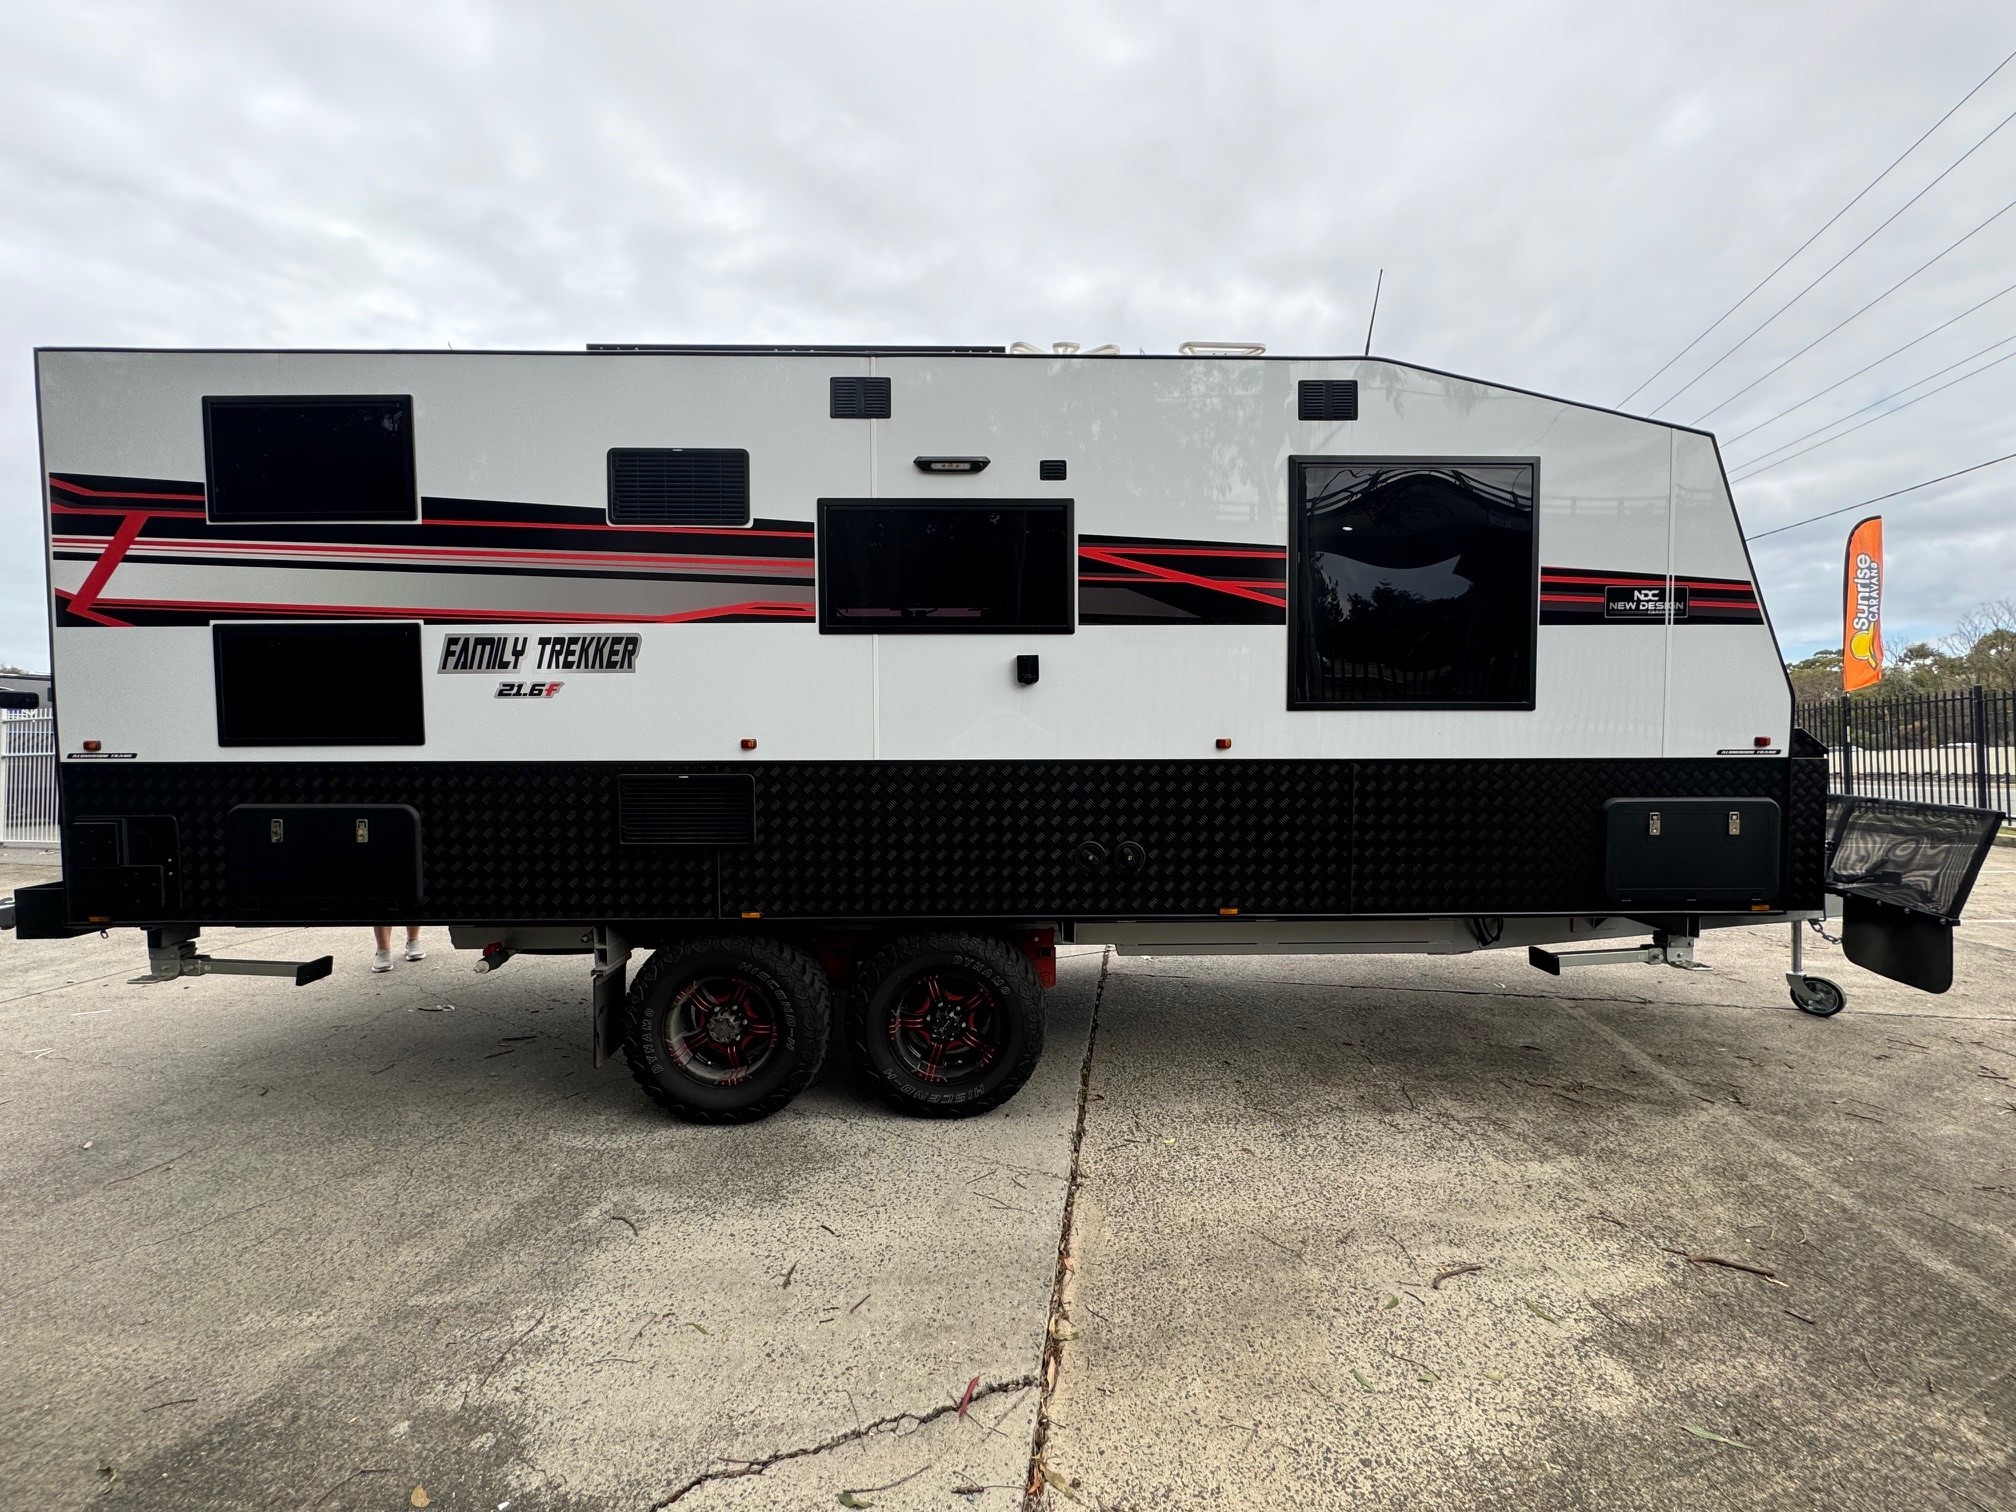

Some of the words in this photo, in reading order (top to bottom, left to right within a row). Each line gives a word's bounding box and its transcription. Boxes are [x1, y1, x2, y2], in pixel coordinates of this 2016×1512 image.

[1609, 601, 1637, 610] NEW
[1633, 589, 1660, 601] NDC
[1853, 553, 1872, 630] Sunrise
[441, 636, 529, 670] FAMILY
[537, 636, 639, 670] TREKKER
[497, 683, 561, 697] 21.6F
[952, 954, 1011, 996] DYNAMO
[641, 1008, 664, 1075] DYNAMO
